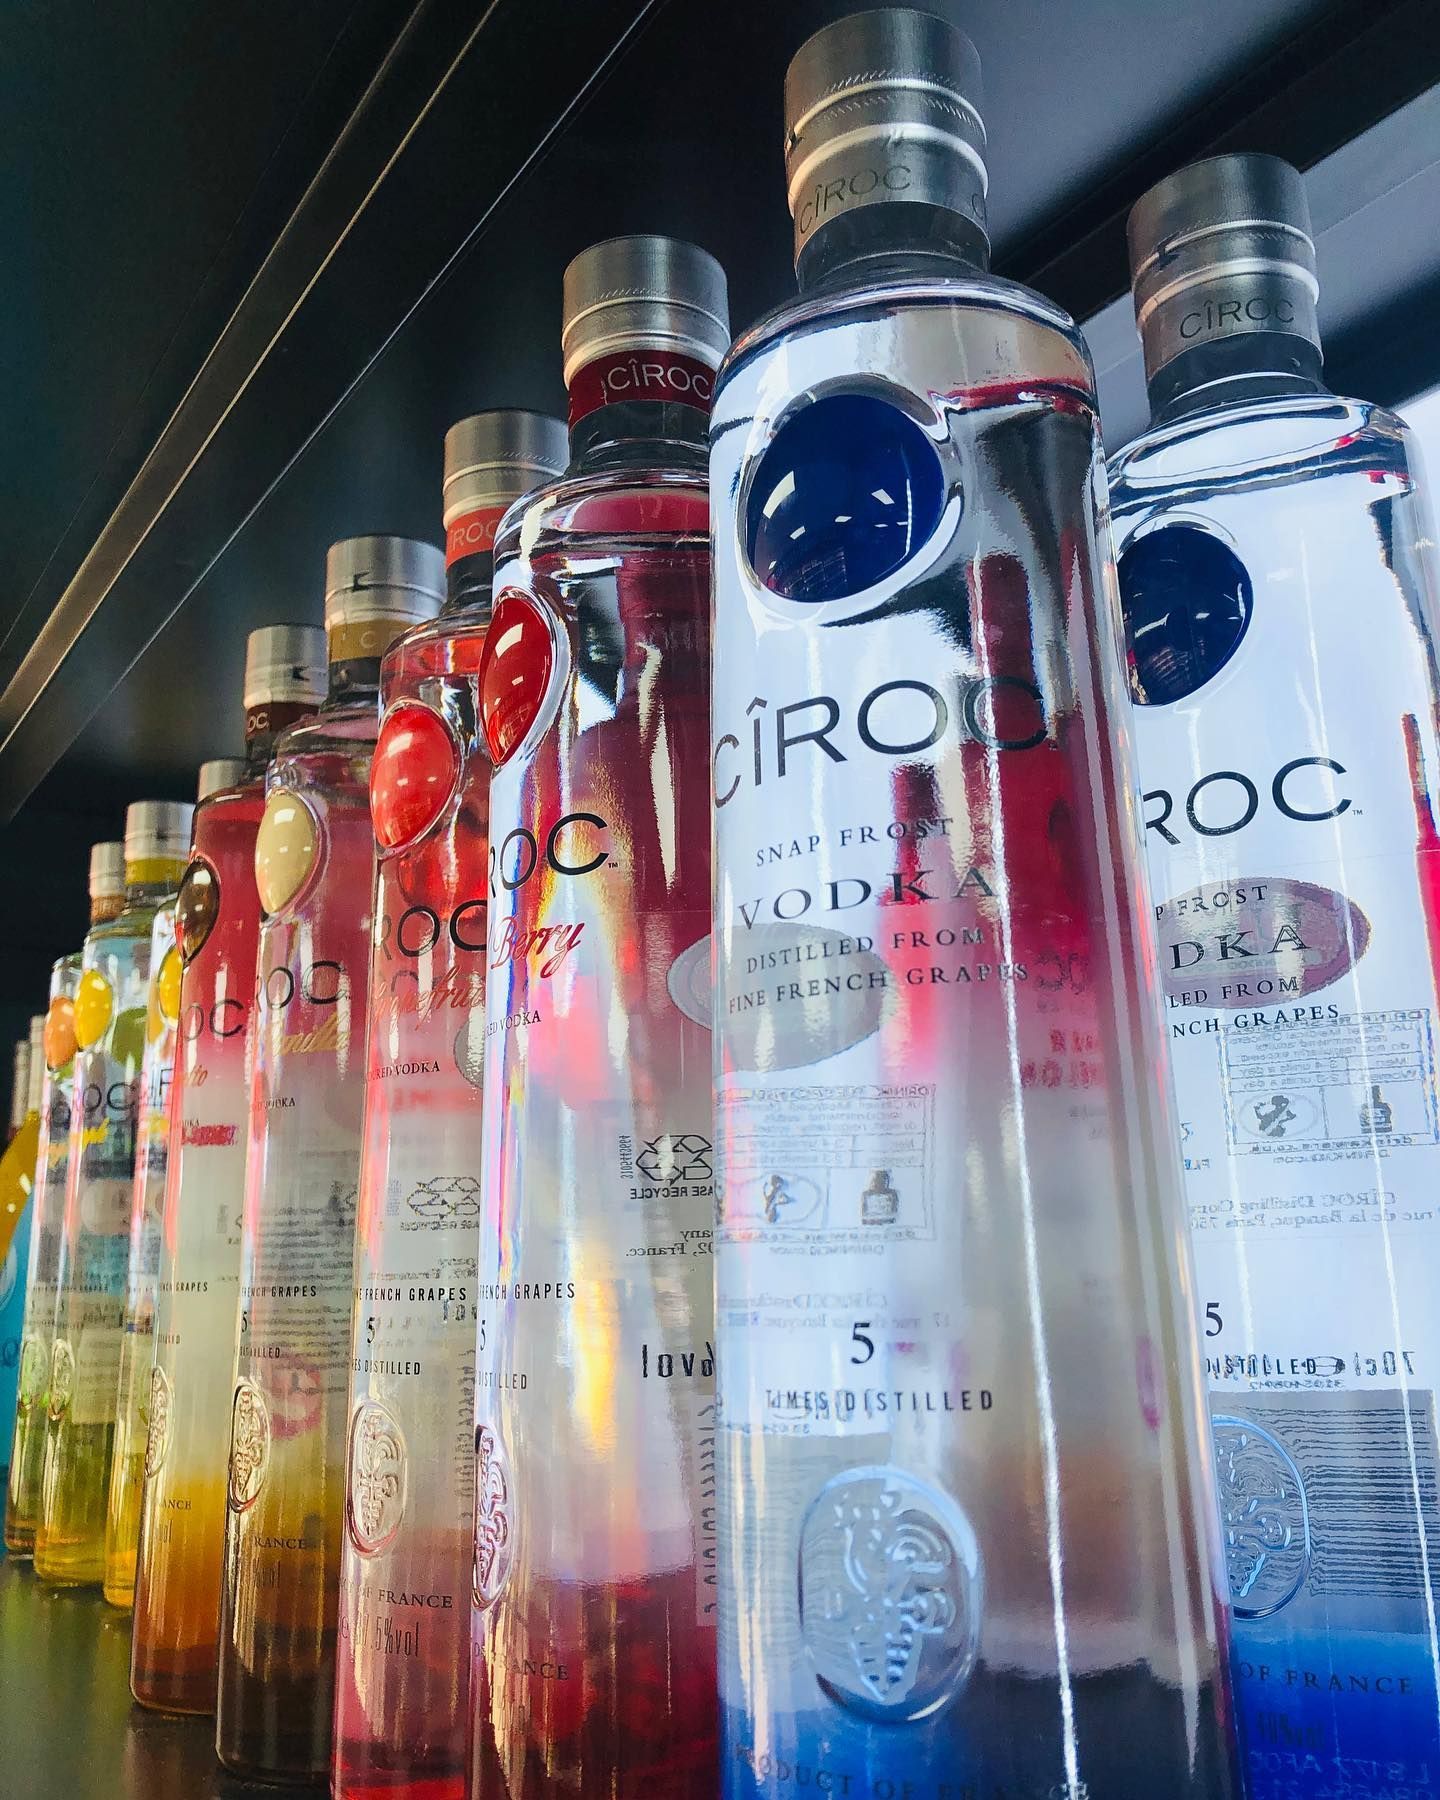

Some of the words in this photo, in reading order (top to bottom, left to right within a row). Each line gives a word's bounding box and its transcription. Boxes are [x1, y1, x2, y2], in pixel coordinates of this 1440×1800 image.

[607, 358, 711, 400] CÎROC
[713, 675, 1049, 808] CÎROC
[756, 834, 822, 867] SNAP
[839, 817, 954, 847] FROST
[738, 866, 999, 931] VODKA
[1177, 885, 1269, 915] FROST
[488, 914, 585, 979] Berry
[747, 935, 874, 973] DISTILLED
[893, 927, 984, 950] FROM
[729, 989, 767, 1014] FINE
[776, 969, 889, 1004] FRENCH
[906, 963, 1029, 986] GRAPES
[1221, 976, 1300, 1000] FROM
[500, 1009, 542, 1031] VODKA
[1233, 1003, 1339, 1029] GRAPES
[395, 1060, 440, 1077] VODKA
[175, 1281, 208, 1292] GRAPES
[271, 1285, 317, 1298] GRAPES
[365, 1288, 401, 1301] FRENCH
[409, 1287, 467, 1301] GRAPES
[514, 1282, 576, 1299] GRAPES
[366, 1317, 375, 1344] 5
[1205, 1302, 1224, 1337] 5
[850, 1322, 875, 1364] 5
[365, 1361, 421, 1376] DISTILLED
[845, 1389, 994, 1412] DISTILLED
[378, 1588, 453, 1609] FRANCE
[1239, 1661, 1270, 1681] OF
[1286, 1670, 1415, 1695] FRANCE
